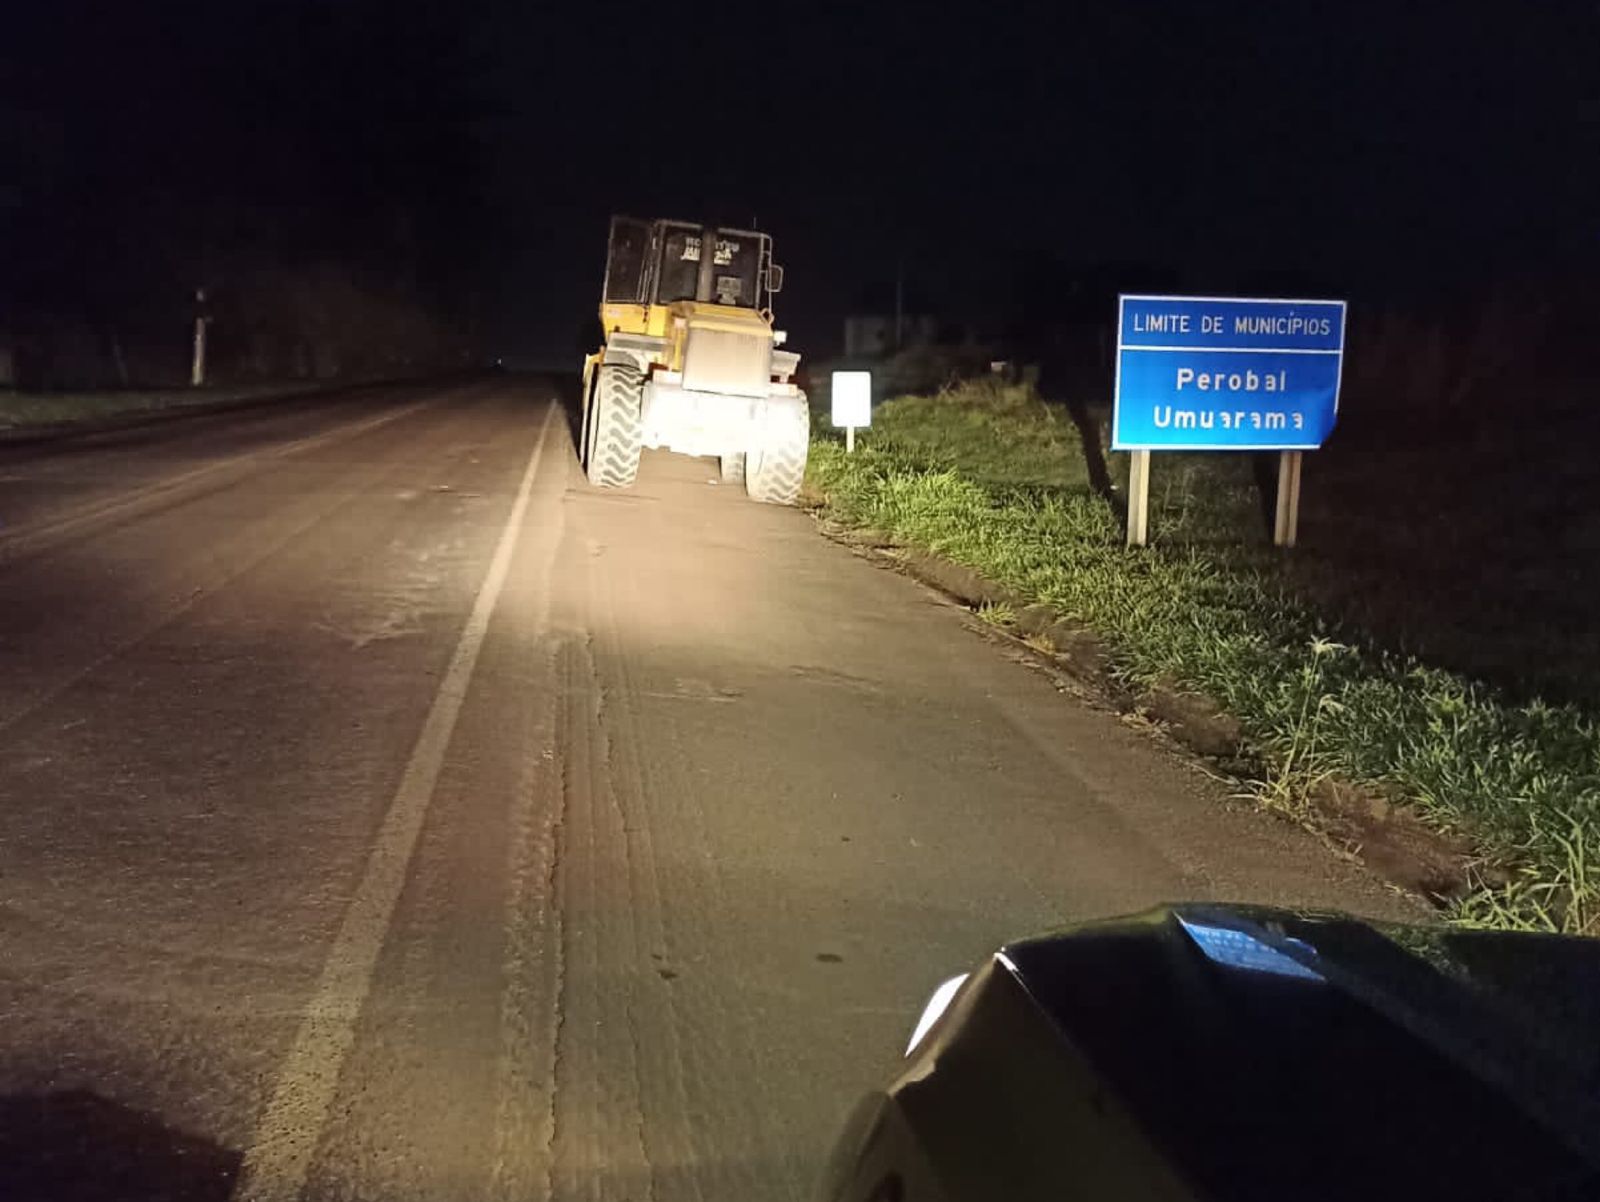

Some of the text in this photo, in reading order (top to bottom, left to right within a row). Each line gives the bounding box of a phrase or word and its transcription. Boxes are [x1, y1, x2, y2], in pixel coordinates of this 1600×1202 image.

[1134, 310, 1331, 336] LIMITE DE MUNICÍPIOS
[1176, 368, 1286, 392] Perobal
[1153, 405, 1304, 430] Umuarama
